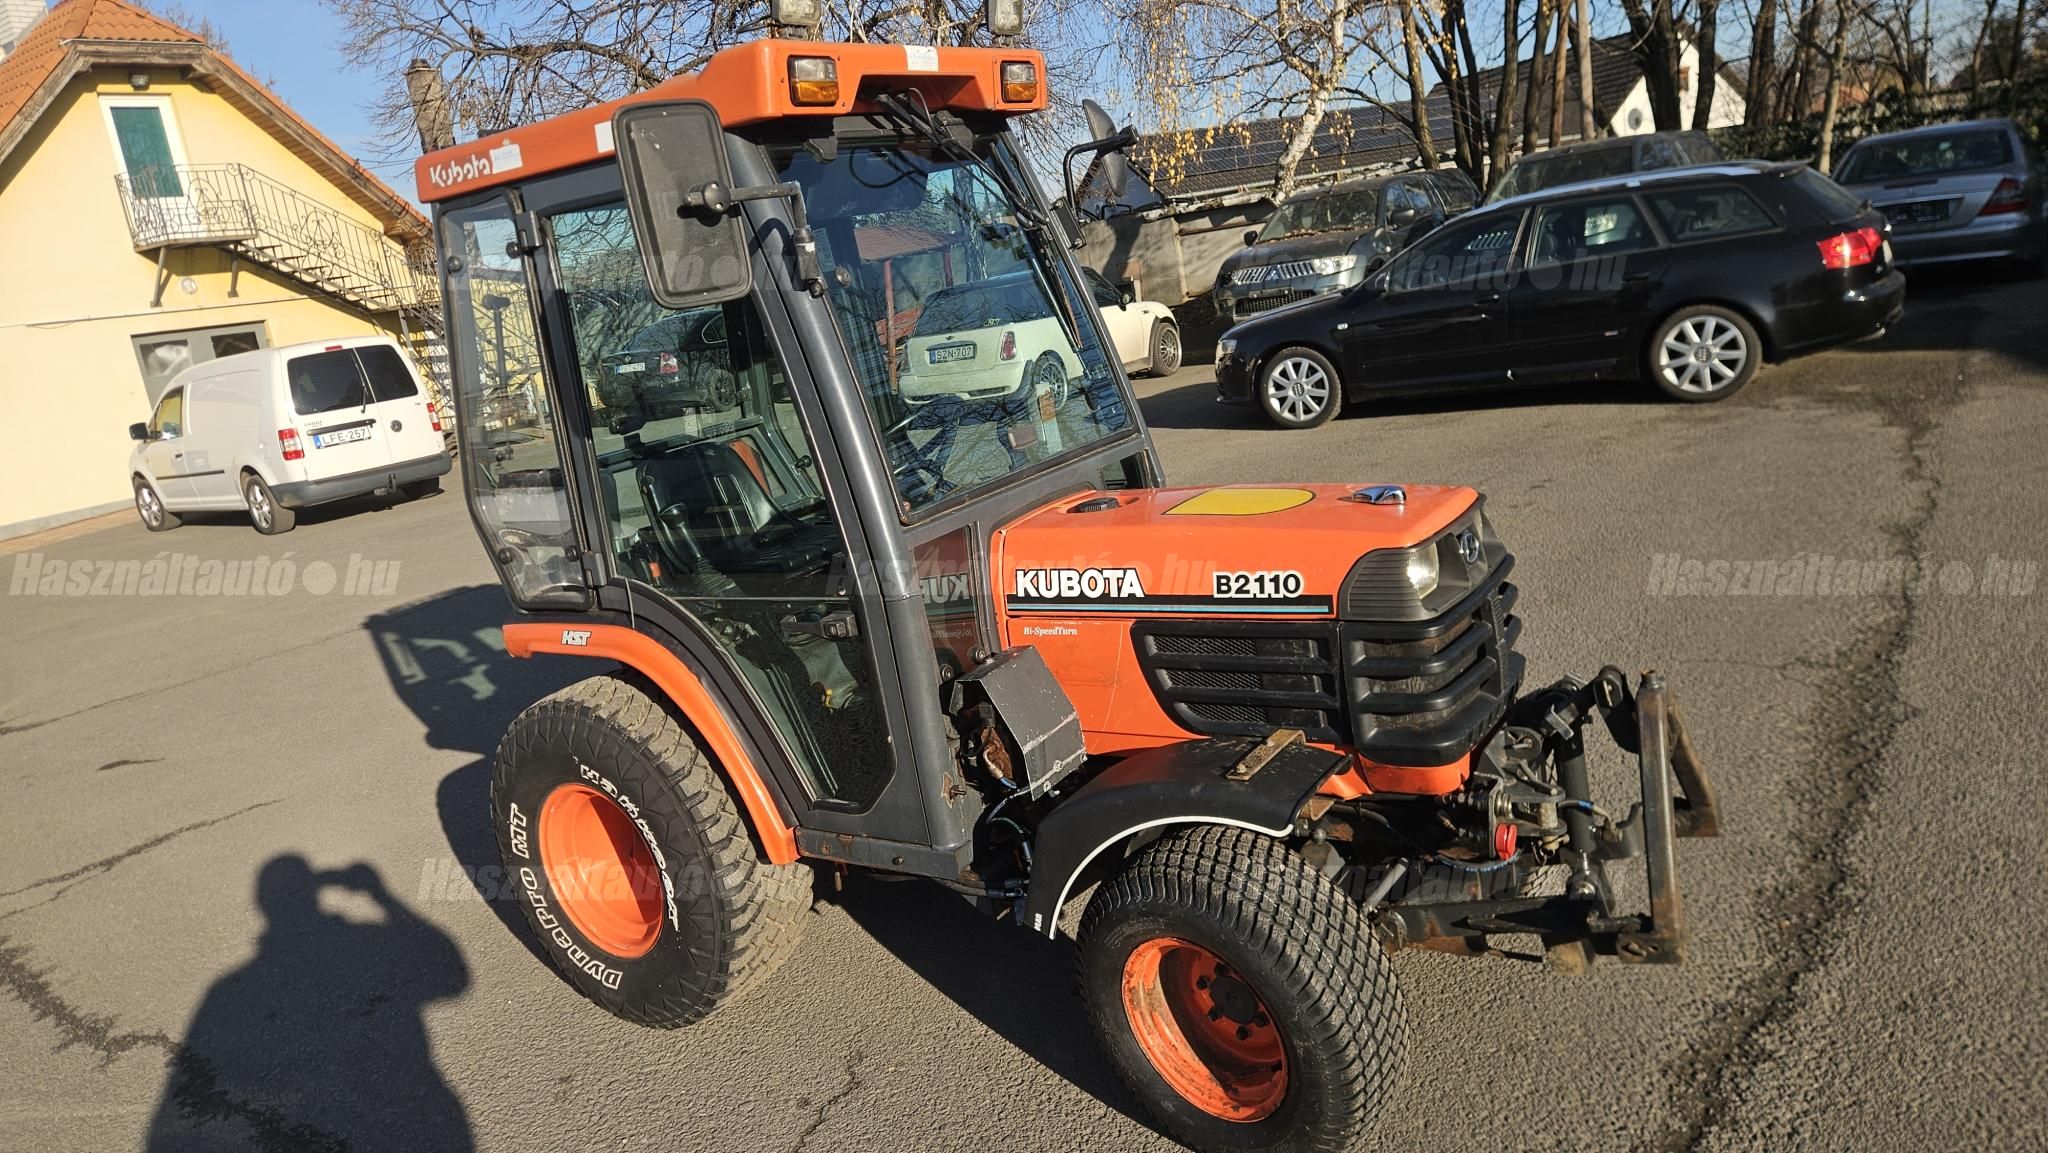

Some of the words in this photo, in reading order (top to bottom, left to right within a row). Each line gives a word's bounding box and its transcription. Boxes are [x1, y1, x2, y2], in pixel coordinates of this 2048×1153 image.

[430, 154, 491, 187] Kubota
[936, 346, 972, 360] SZN-707
[321, 428, 366, 445] LFE-257
[1015, 568, 1145, 598] KUBOTA
[1214, 571, 1303, 598] B2110
[561, 630, 591, 646] HST
[1023, 626, 1078, 637] Bi-SpeedTurn
[510, 802, 529, 859] MT
